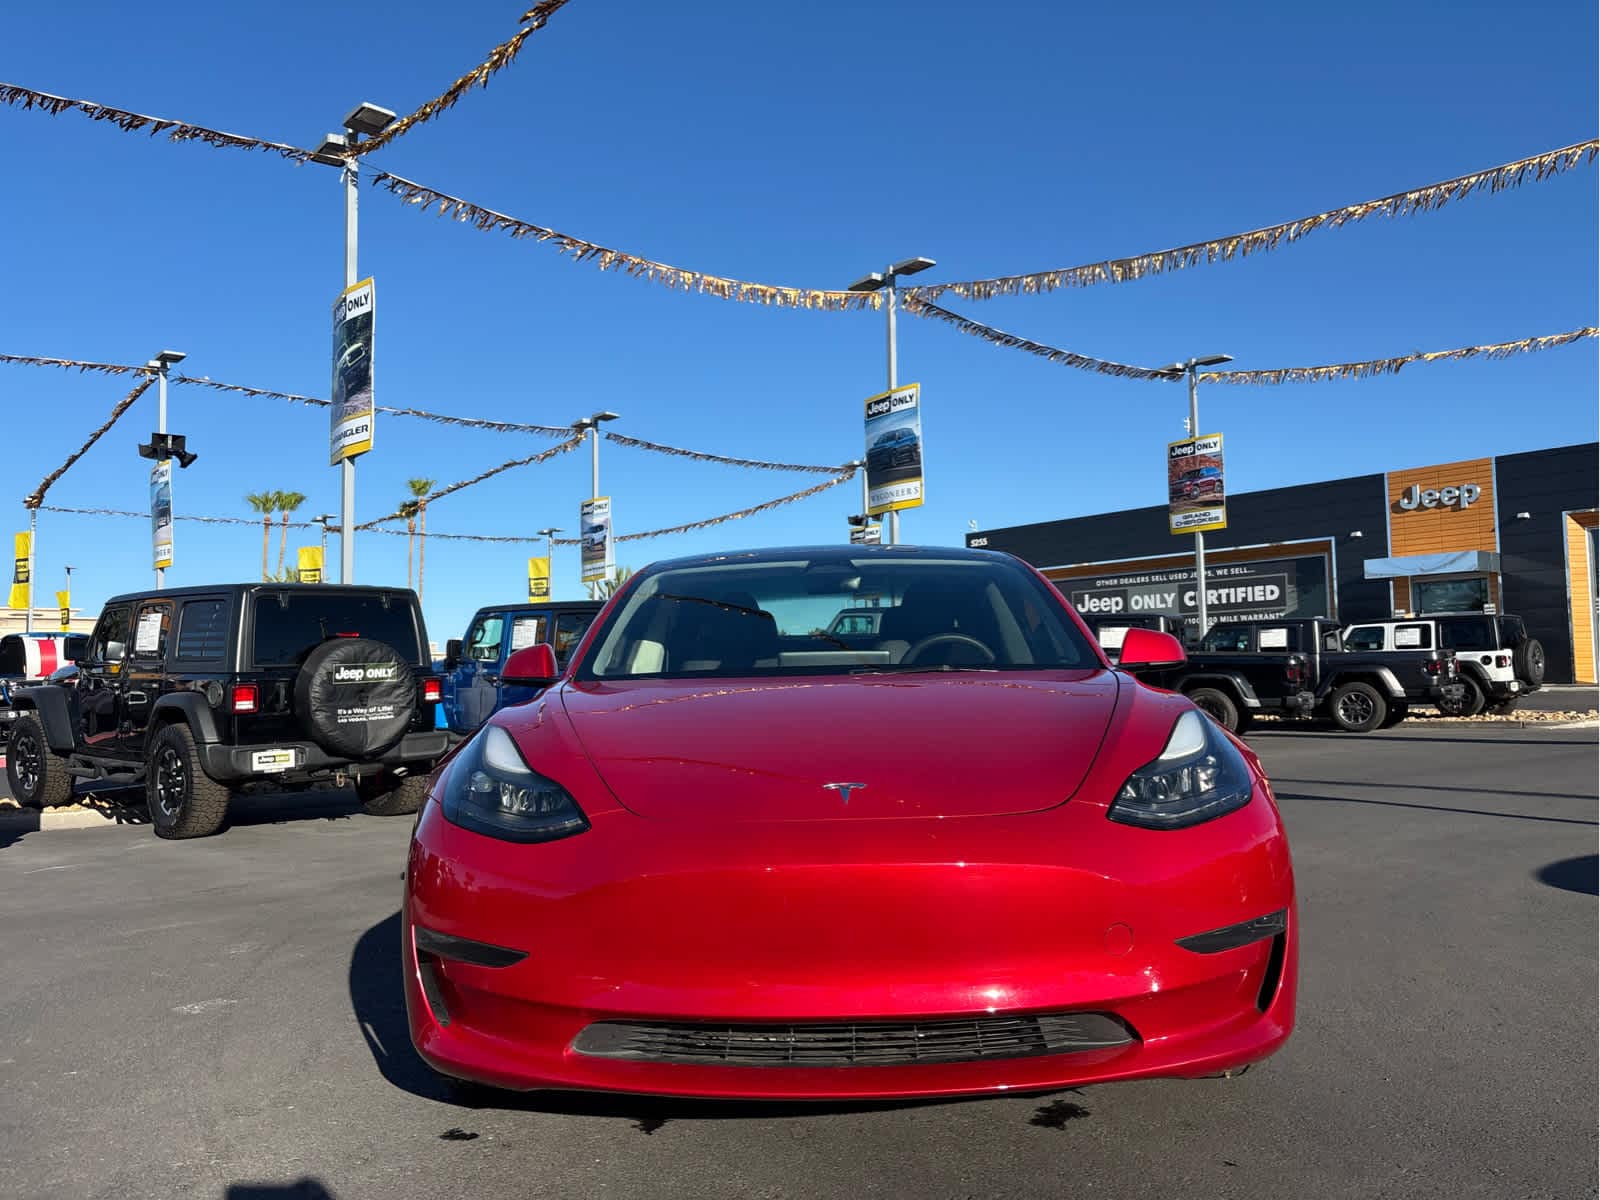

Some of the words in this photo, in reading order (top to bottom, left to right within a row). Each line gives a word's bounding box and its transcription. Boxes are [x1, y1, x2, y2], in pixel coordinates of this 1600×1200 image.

[347, 292, 370, 312] ONLY
[868, 401, 890, 415] Jeep
[892, 393, 914, 406] ONLY
[1171, 445, 1194, 456] Jeep
[1196, 441, 1218, 451] ONLY
[1400, 483, 1481, 510] Jeep
[1175, 516, 1220, 526] CHEROKEE
[1096, 579, 1118, 587] OTHER
[1119, 576, 1150, 585] DEALERS
[1151, 574, 1167, 583] SELL
[1168, 572, 1188, 580] USED
[1216, 568, 1229, 576] WE
[1076, 594, 1124, 614] Jeep
[1130, 593, 1176, 610] ONLY
[1183, 585, 1280, 607] CRTIFIED
[1219, 615, 1239, 624] MILE
[1239, 612, 1286, 621] WARRANTY
[335, 667, 364, 680] Jeep
[366, 667, 394, 679] ONLY
[352, 707, 368, 715] Way
